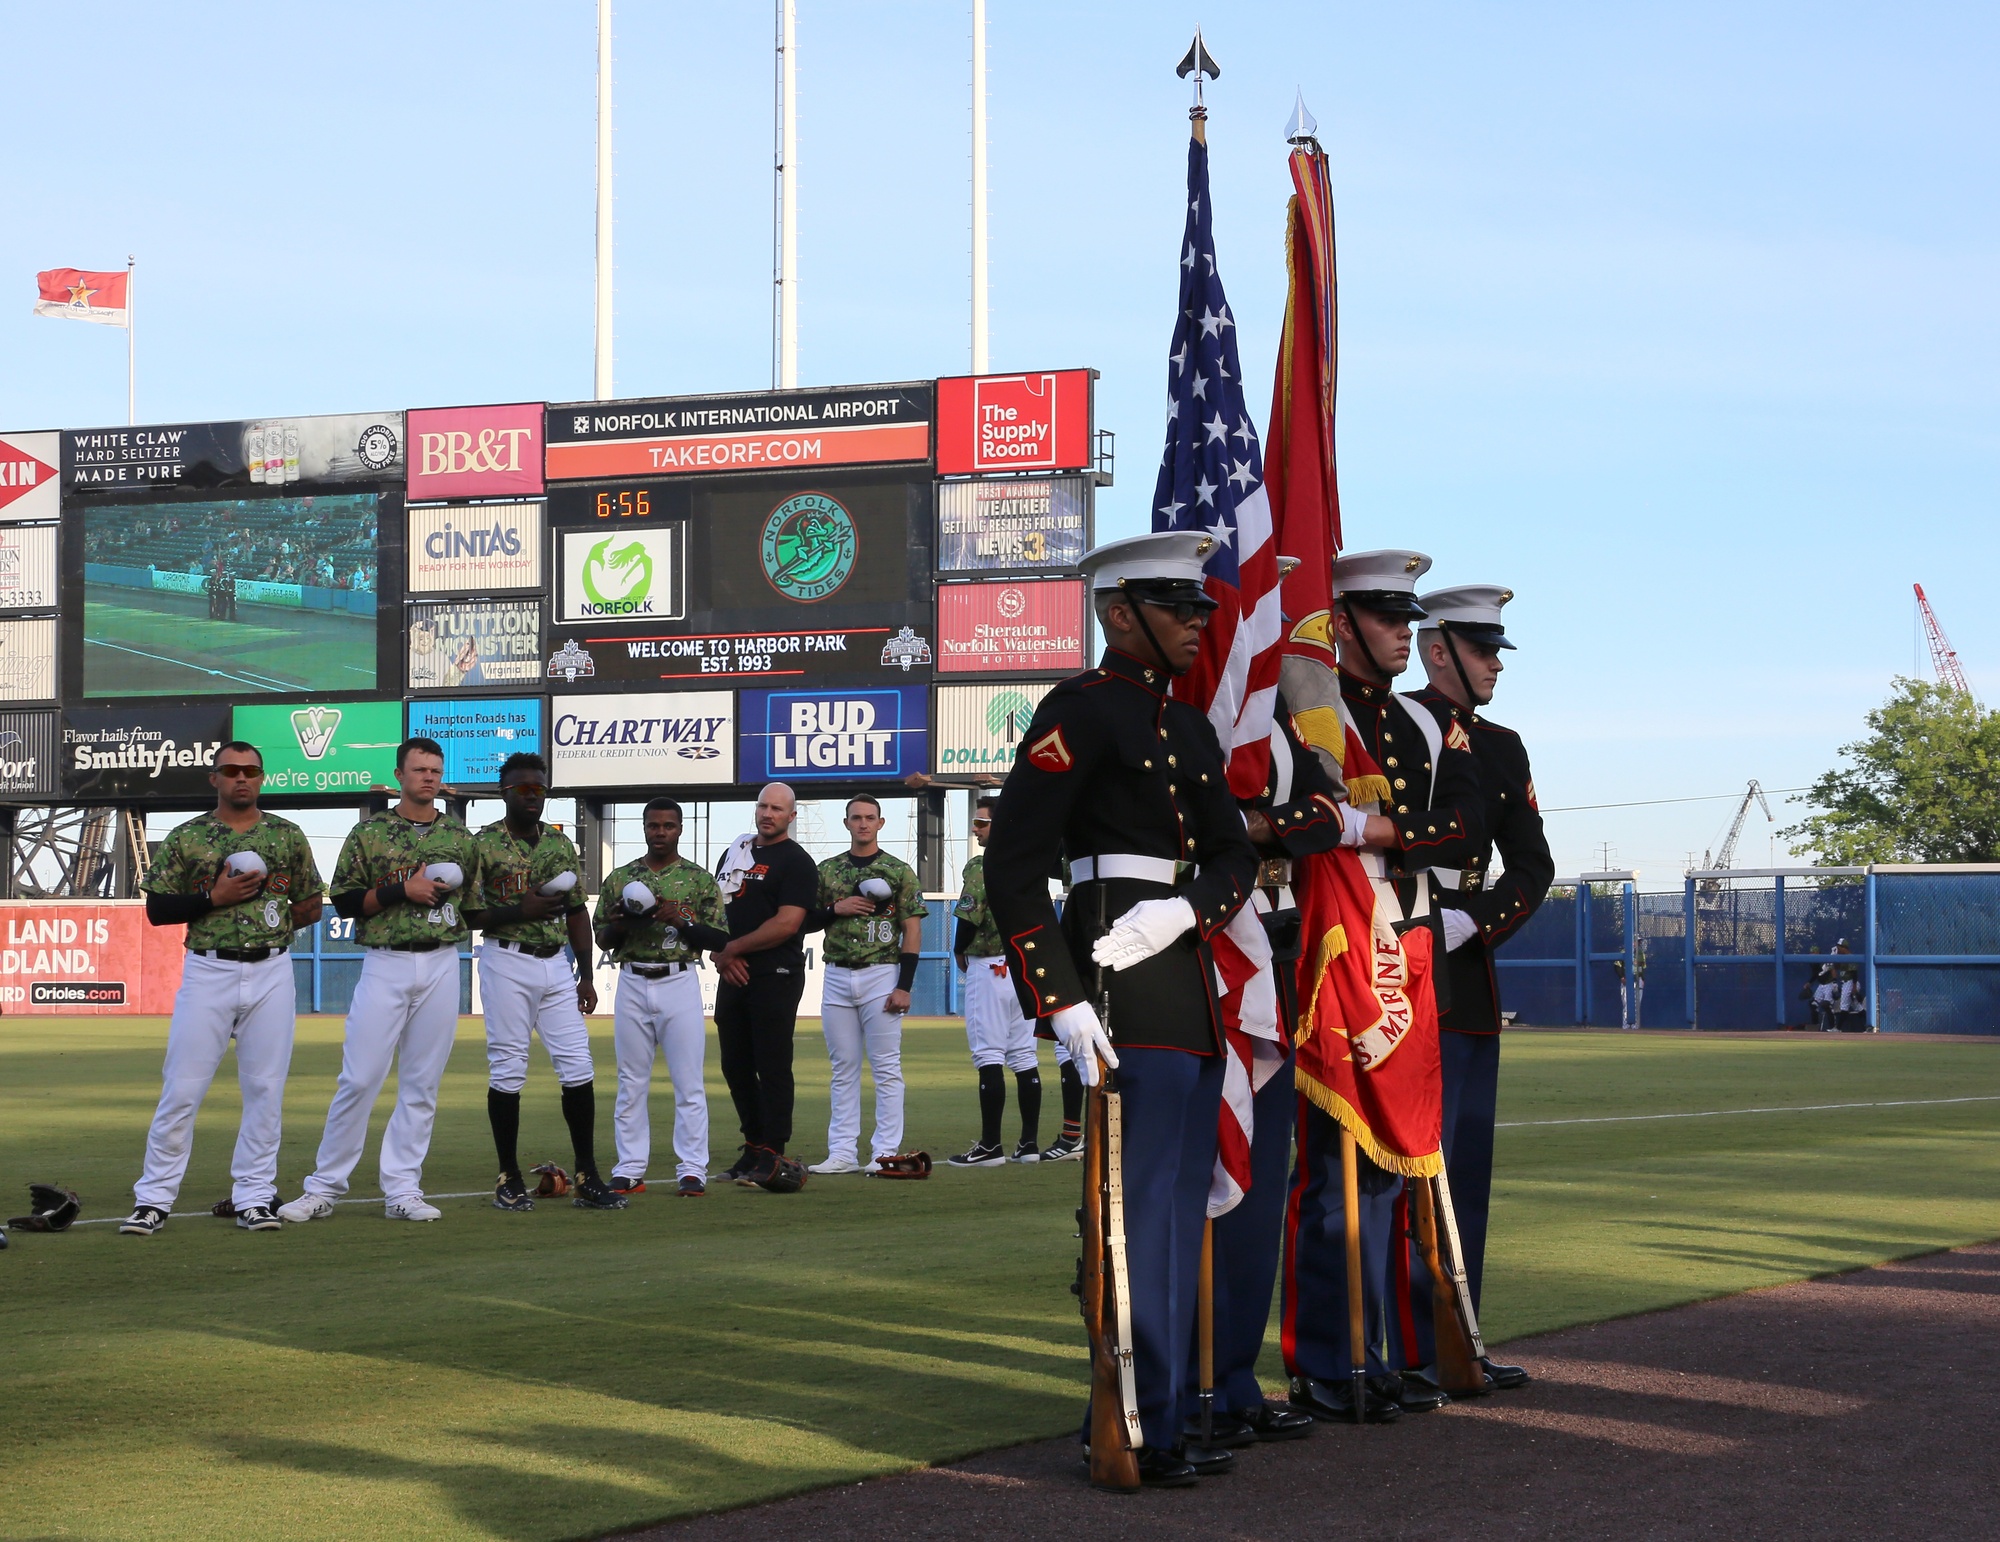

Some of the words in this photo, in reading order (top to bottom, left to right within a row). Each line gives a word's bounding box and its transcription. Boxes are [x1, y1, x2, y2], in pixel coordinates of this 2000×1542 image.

[594, 412, 677, 433] NORFOLK
[681, 405, 819, 427] INTERNATIONAL
[822, 399, 900, 419] AIRPORT
[981, 404, 1018, 422] The
[74, 433, 129, 448] WHITE
[135, 431, 182, 446] CLAW
[367, 426, 396, 446] CALORIES
[981, 420, 1049, 443] Supply
[75, 450, 115, 462] HARD
[121, 447, 180, 460] SELTZER
[370, 439, 387, 450] 5%
[418, 428, 532, 476] BB&T
[648, 439, 822, 468] TAKEORF.COM
[982, 441, 1039, 459] Room
[360, 451, 381, 470] GLUTEN
[381, 450, 396, 468] FREE
[74, 468, 127, 482] MADE
[136, 465, 182, 480] PURE
[1006, 485, 1050, 497] WARNING
[596, 491, 651, 517] 6:56
[977, 498, 1050, 517] WEATHER
[765, 497, 839, 542] NORFOLK
[942, 519, 987, 534] GETTING
[989, 517, 1032, 532] RESULTS
[1034, 517, 1055, 531] FOR
[975, 535, 1023, 556] NEWS
[1023, 532, 1046, 561] 3
[418, 563, 447, 573] READY
[449, 562, 467, 571] FOR
[469, 561, 486, 570] THE
[488, 560, 532, 569] WORKDAY
[797, 569, 845, 597] TIDES
[581, 600, 654, 616] NORFOLK
[434, 609, 540, 637] TUITION
[974, 623, 1048, 638] Sheraton
[434, 633, 540, 657] MONSTER
[627, 640, 705, 658] WELCOME
[708, 639, 731, 656] TO
[734, 636, 801, 654] HARBOR
[804, 634, 847, 652] PARK
[942, 638, 1000, 653] Norfolk
[1003, 636, 1080, 651] Waterside
[700, 656, 734, 673] EST.
[737, 655, 772, 672] 1993
[982, 654, 1039, 664] HOTEL
[424, 713, 473, 727] Hampton
[475, 712, 506, 724] Roads
[508, 712, 526, 723] has
[790, 700, 876, 734] BUD
[62, 729, 100, 744] Flavor
[100, 727, 129, 742] hails
[126, 725, 162, 748] from
[413, 728, 427, 739] 30
[429, 727, 475, 739] locations
[476, 726, 514, 740] serving
[515, 728, 537, 740] you.
[554, 714, 727, 747] CHARTWAY
[74, 739, 222, 778] Smithfield
[556, 749, 598, 760] FEDERAL
[600, 748, 634, 759] CREDIT
[636, 748, 670, 758] UNION
[774, 733, 892, 768] LIGHT
[262, 768, 310, 787] we're
[315, 769, 372, 791] game
[466, 765, 481, 774] The
[11, 780, 35, 790] Union
[263, 900, 280, 928] 6
[8, 919, 78, 944] LAND
[86, 918, 109, 945] IS
[329, 916, 355, 939] 37
[661, 925, 689, 951] 2
[866, 920, 893, 943] 18
[0, 949, 95, 975] DLAND.
[34, 986, 121, 1000] Orioles.com
[1375, 937, 1409, 1046] MARINE
